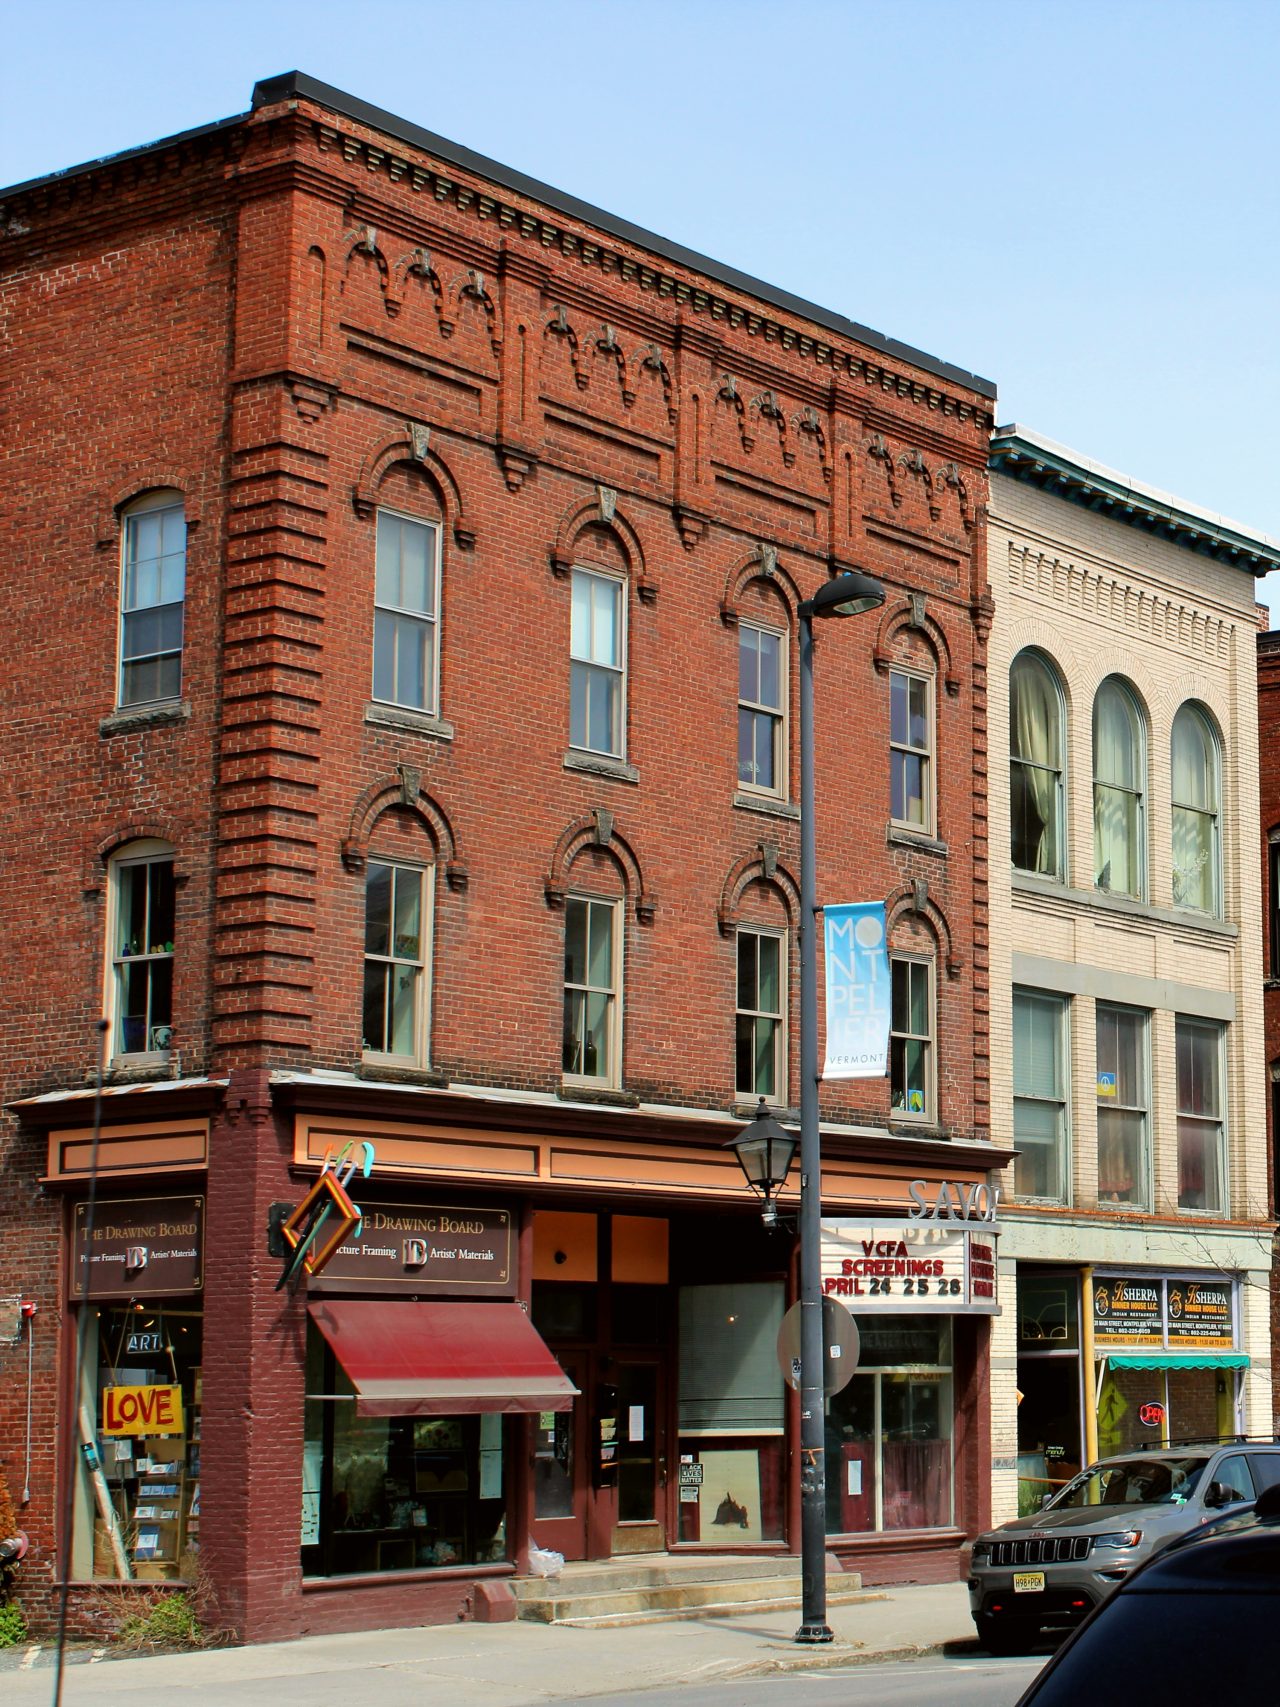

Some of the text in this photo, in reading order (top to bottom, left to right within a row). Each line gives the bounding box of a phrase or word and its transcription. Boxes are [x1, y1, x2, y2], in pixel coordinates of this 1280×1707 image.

[828, 916, 883, 949] MO
[829, 948, 884, 982] NT
[830, 983, 886, 1016] PEL
[830, 1053, 884, 1064] VERMONT
[105, 1225, 156, 1240] DRAWING
[159, 1222, 198, 1237] BOARD
[375, 1213, 436, 1232] DRAWING
[439, 1216, 484, 1234] BOARD
[101, 1252, 126, 1263] Framing
[170, 1248, 198, 1258] Materials
[335, 1245, 360, 1255] icture
[362, 1244, 397, 1259] Framing
[458, 1249, 495, 1260] Materials
[861, 1240, 909, 1258] VCFA
[842, 1259, 944, 1276] SCREENINGS
[870, 1278, 891, 1295] 24
[904, 1278, 929, 1295] 25
[128, 1334, 160, 1351] ART
[106, 1388, 174, 1430] LOVE
[1140, 1404, 1165, 1423] OPEN
